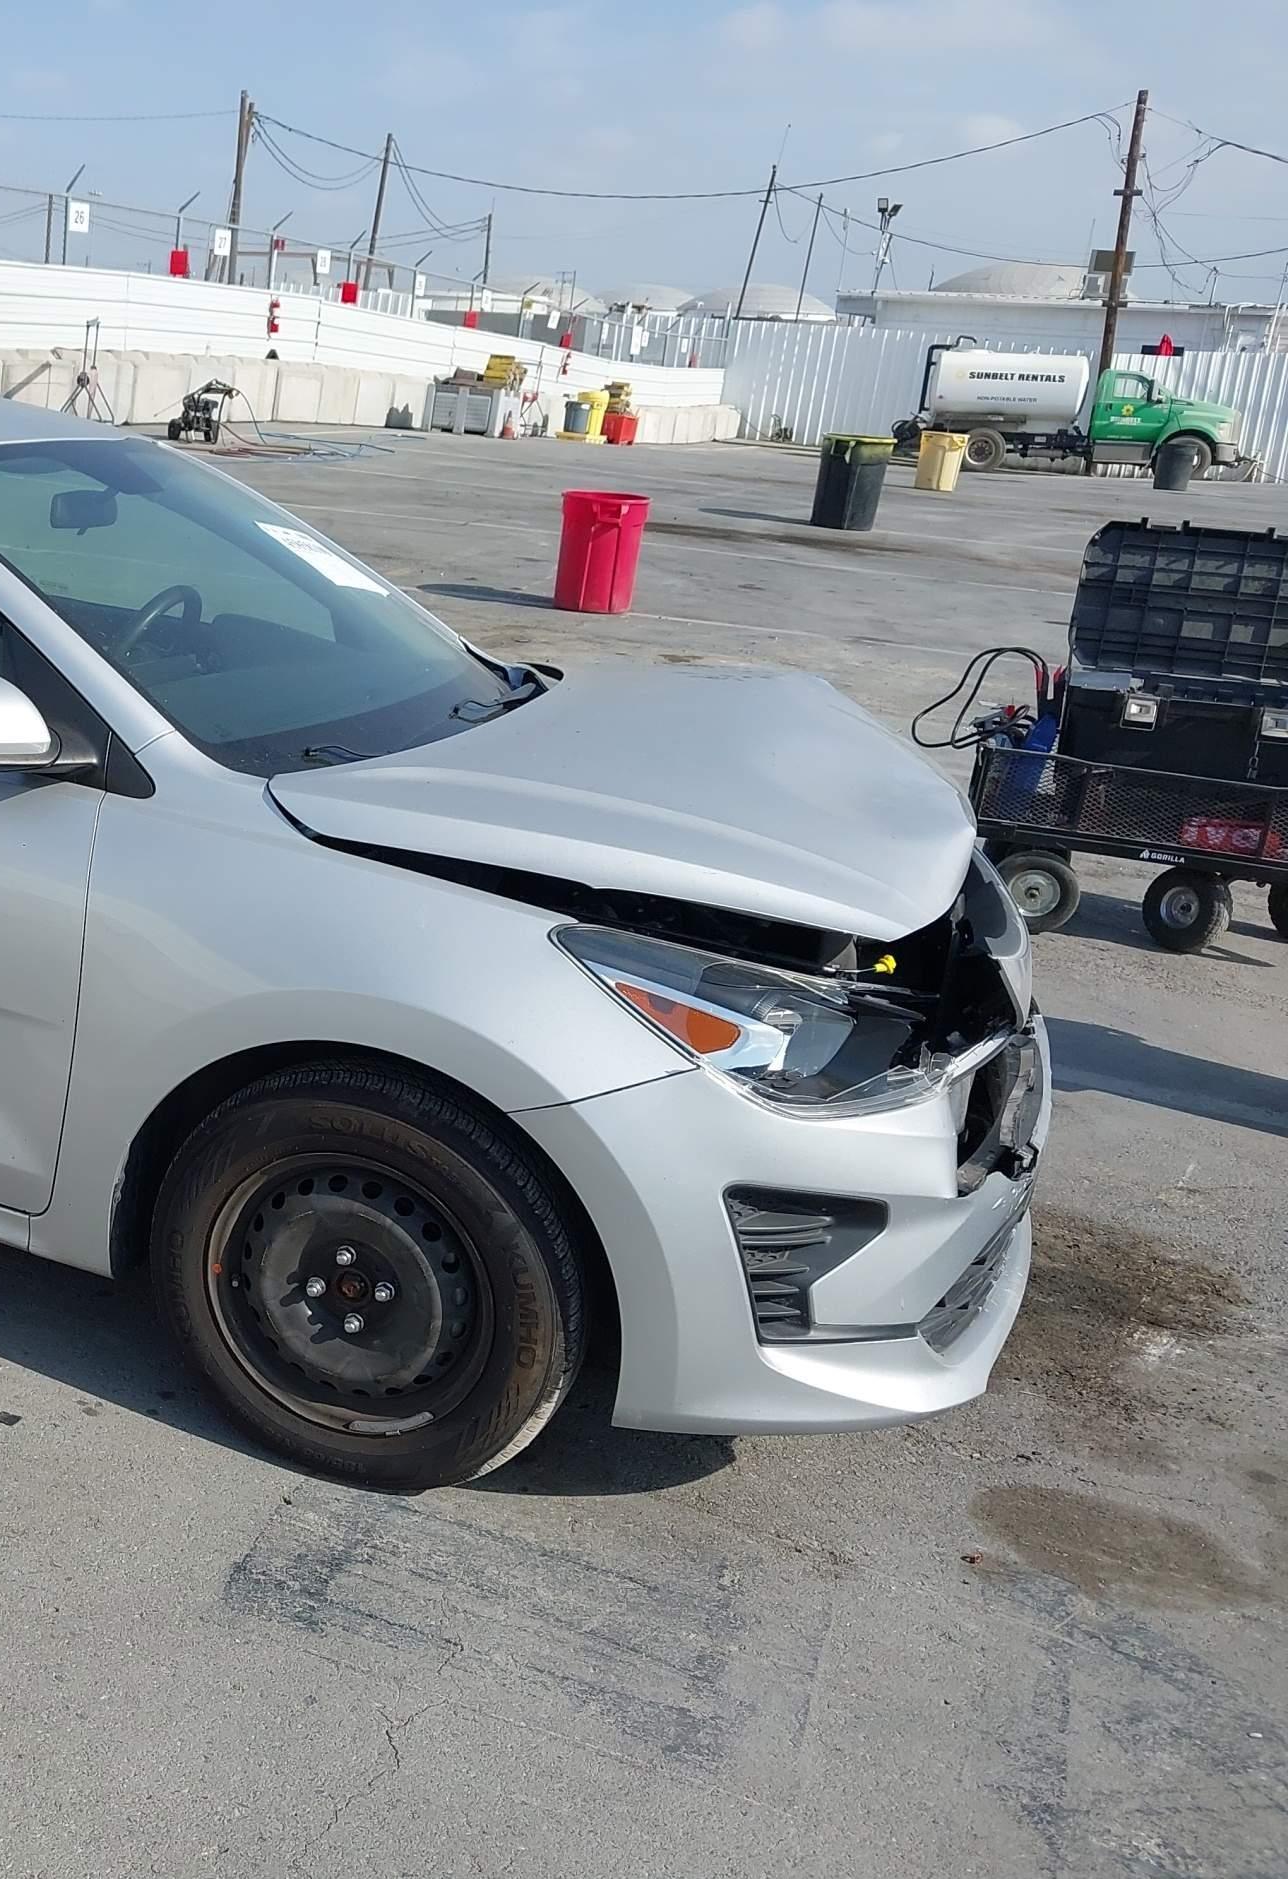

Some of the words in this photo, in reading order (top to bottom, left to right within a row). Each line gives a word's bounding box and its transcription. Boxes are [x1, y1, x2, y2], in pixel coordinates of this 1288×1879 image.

[74, 210, 85, 224] 26
[969, 371, 1016, 381] SUNBELT
[1018, 373, 1065, 383] RENTALS
[1150, 853, 1185, 864] GORILLA
[510, 1244, 539, 1370] KUMHO
